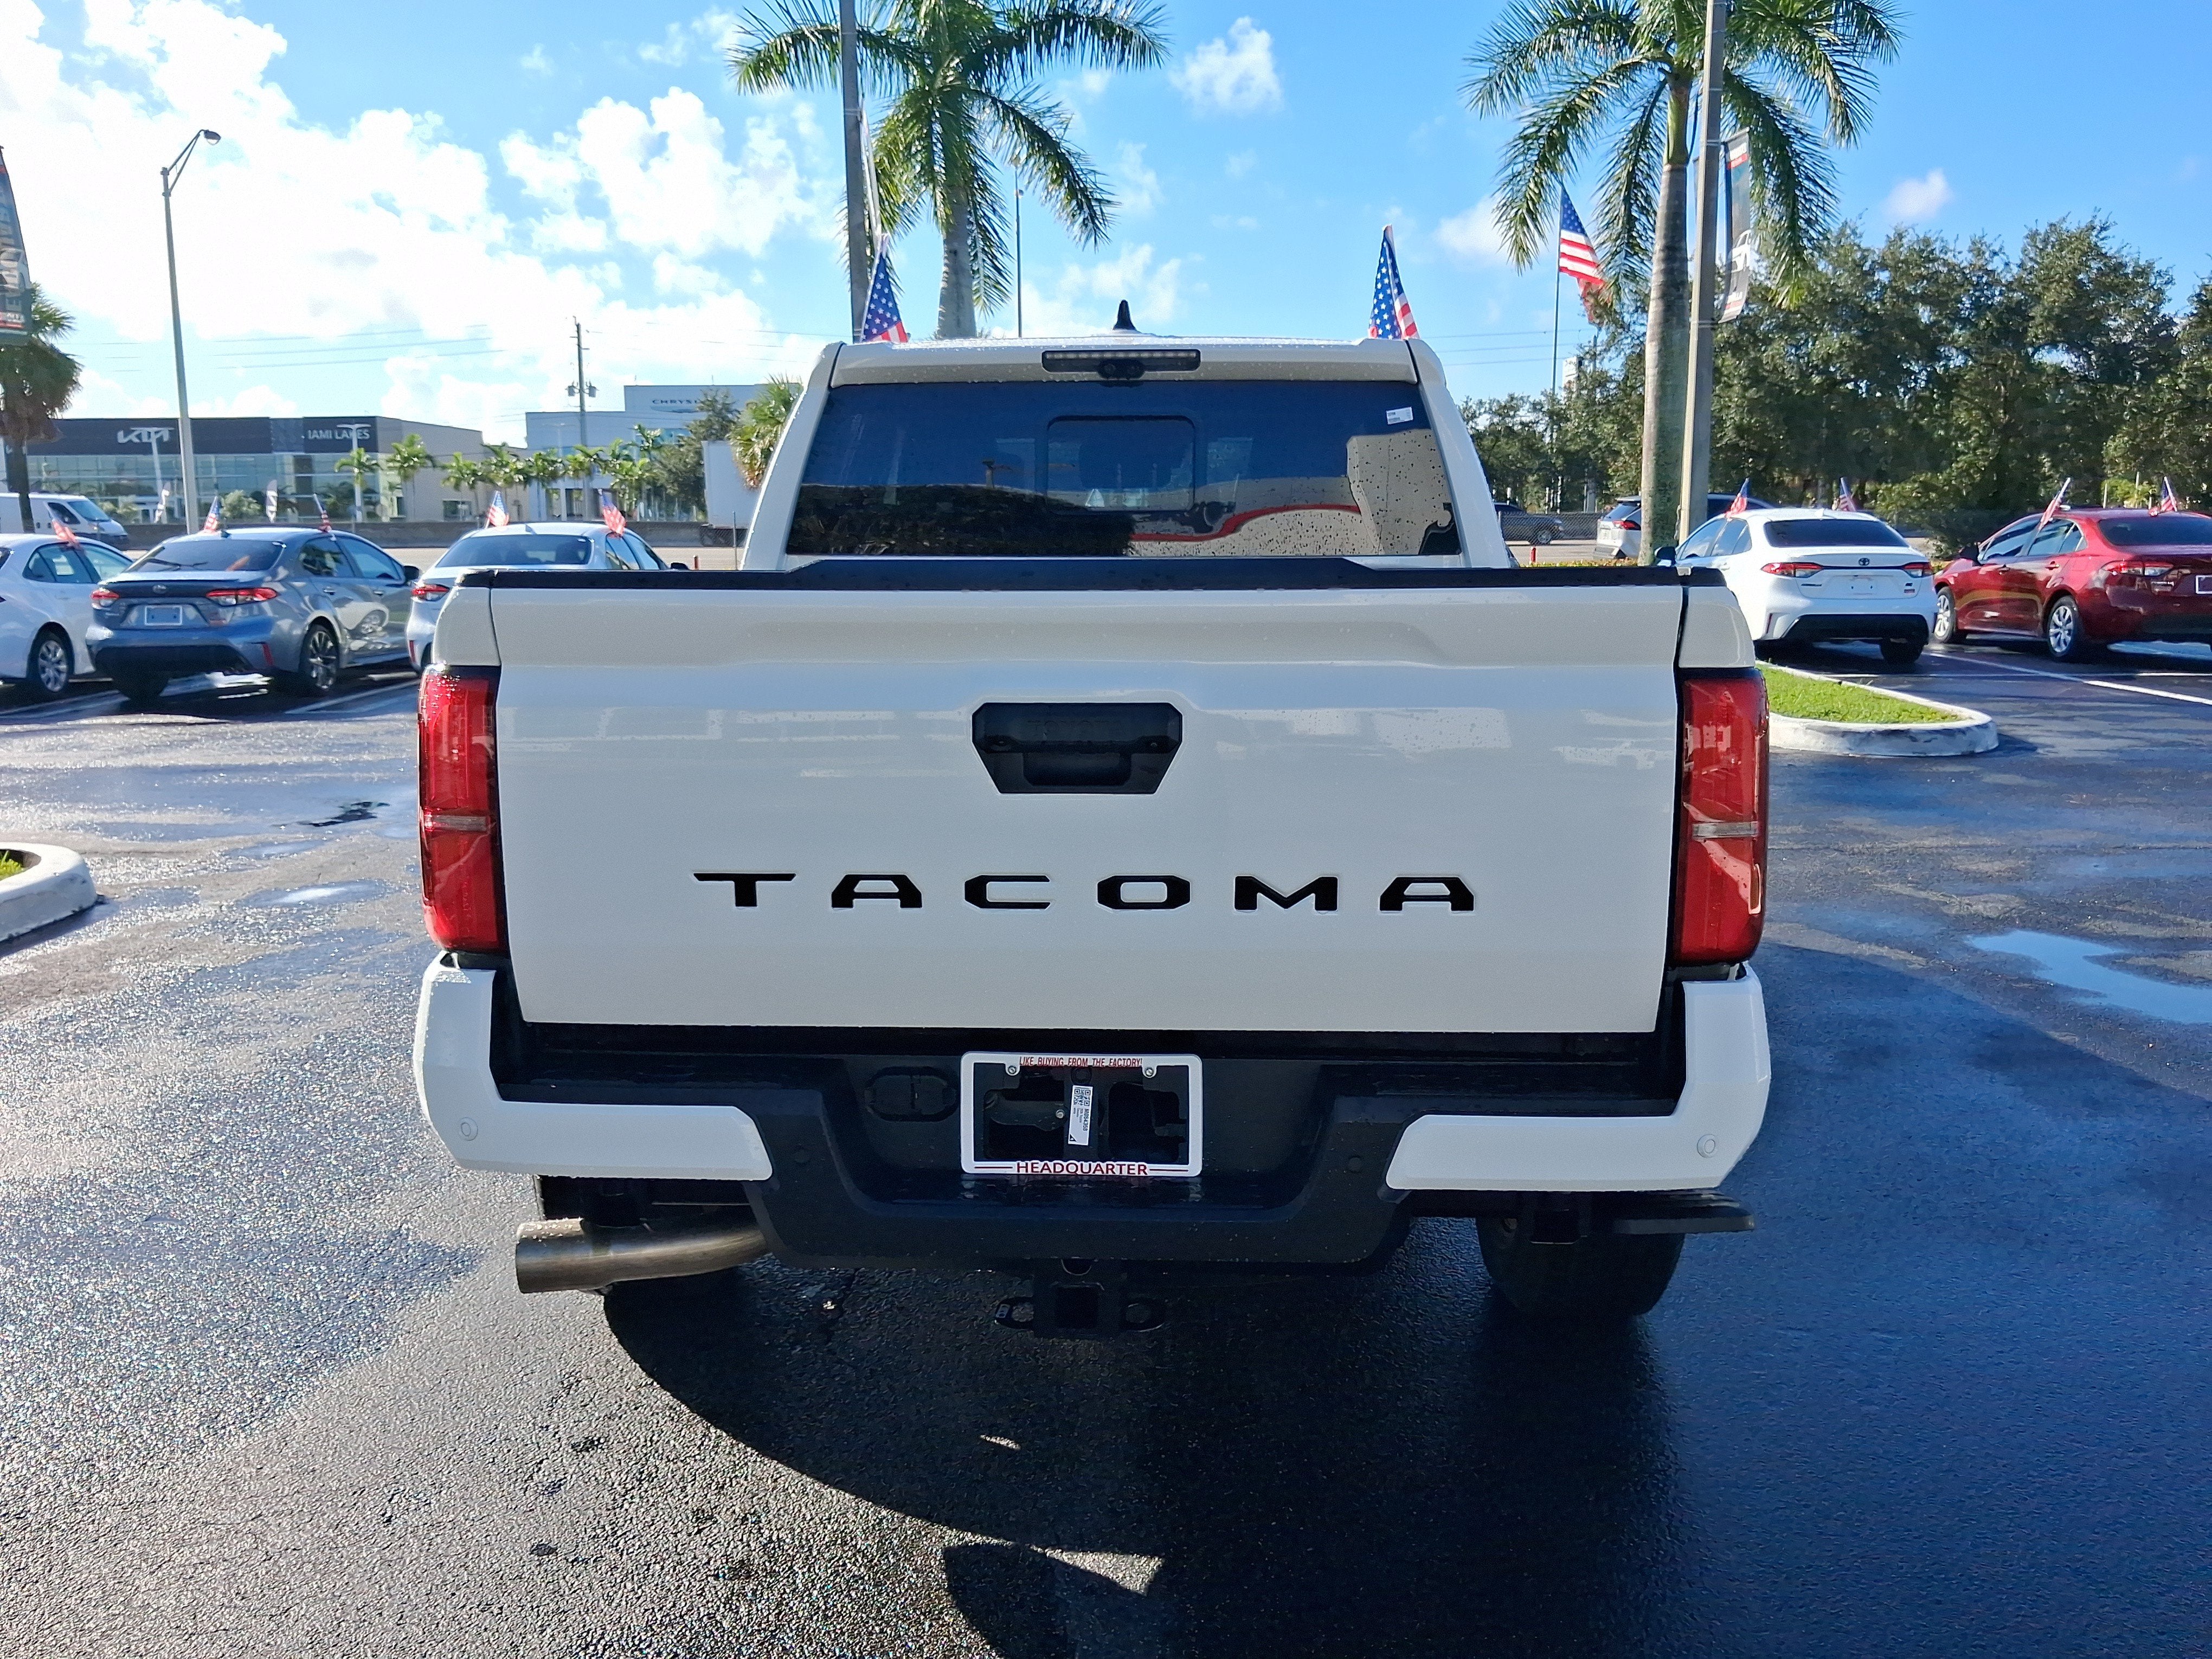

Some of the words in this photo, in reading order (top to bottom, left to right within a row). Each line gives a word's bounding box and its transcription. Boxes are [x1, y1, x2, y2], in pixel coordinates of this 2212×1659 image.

[335, 429, 370, 439] LAES
[693, 873, 1475, 911] TACOMA
[1019, 1056, 1034, 1065] LIKE
[1037, 1057, 1064, 1066] BUYING
[1068, 1058, 1089, 1067] FROM
[1092, 1058, 1105, 1067] THE
[1109, 1058, 1143, 1068] FACTORY!
[1017, 1162, 1148, 1175] HEADQUARTER
